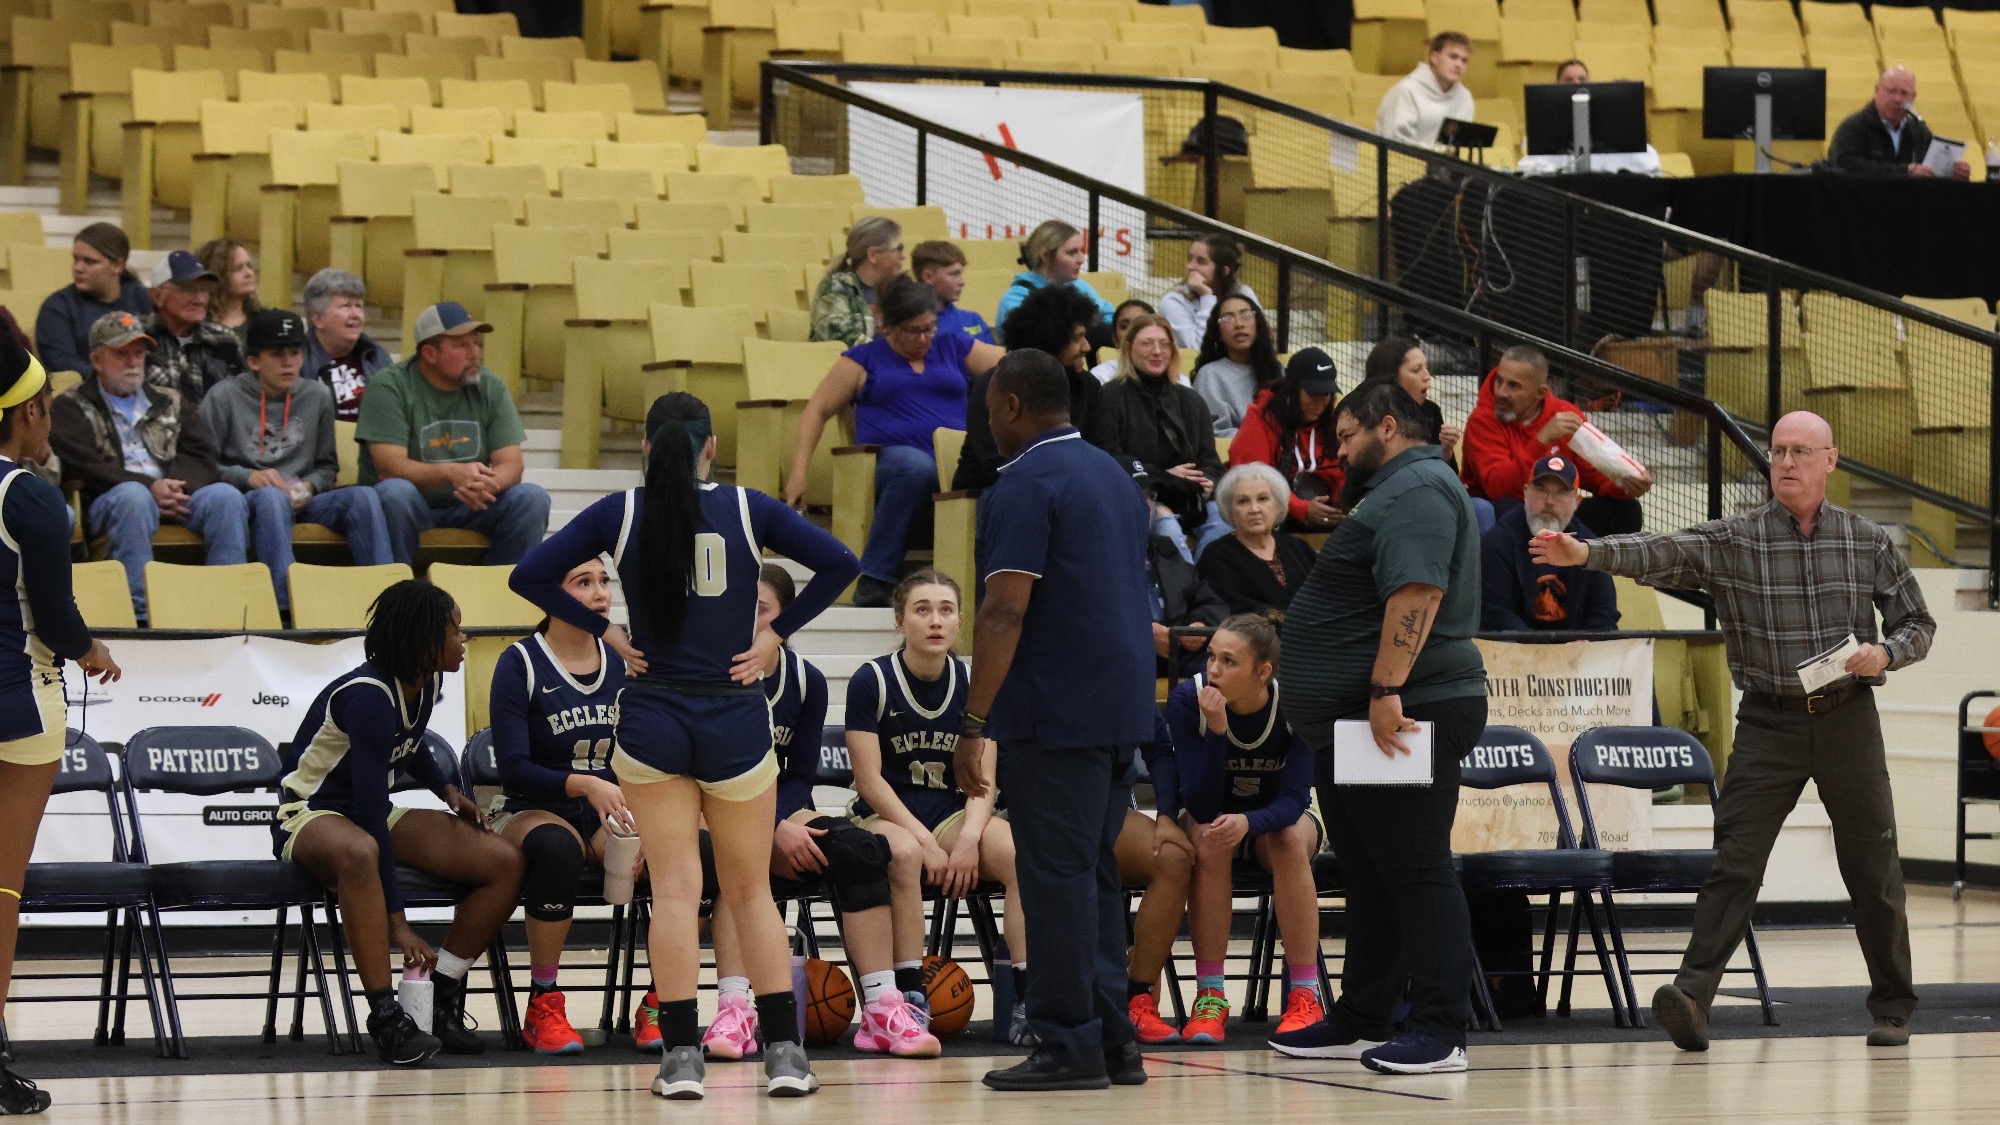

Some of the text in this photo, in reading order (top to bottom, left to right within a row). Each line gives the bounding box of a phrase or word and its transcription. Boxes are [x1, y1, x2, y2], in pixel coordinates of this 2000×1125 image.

[252, 692, 290, 707] Jeep
[1508, 705, 1543, 717] Decks
[1546, 705, 1568, 716] and
[1571, 704, 1603, 716] Much
[1606, 704, 1631, 716] More
[1539, 720, 1555, 733] for
[1558, 721, 1587, 733] Over
[147, 747, 260, 773] PATRIOTS
[571, 737, 612, 771] 11
[1460, 744, 1535, 769] RIOTS
[1594, 745, 1694, 769] PATRIOTS
[1231, 776, 1261, 797] 5
[208, 810, 241, 821] AUTO
[1600, 830, 1629, 842] Road
